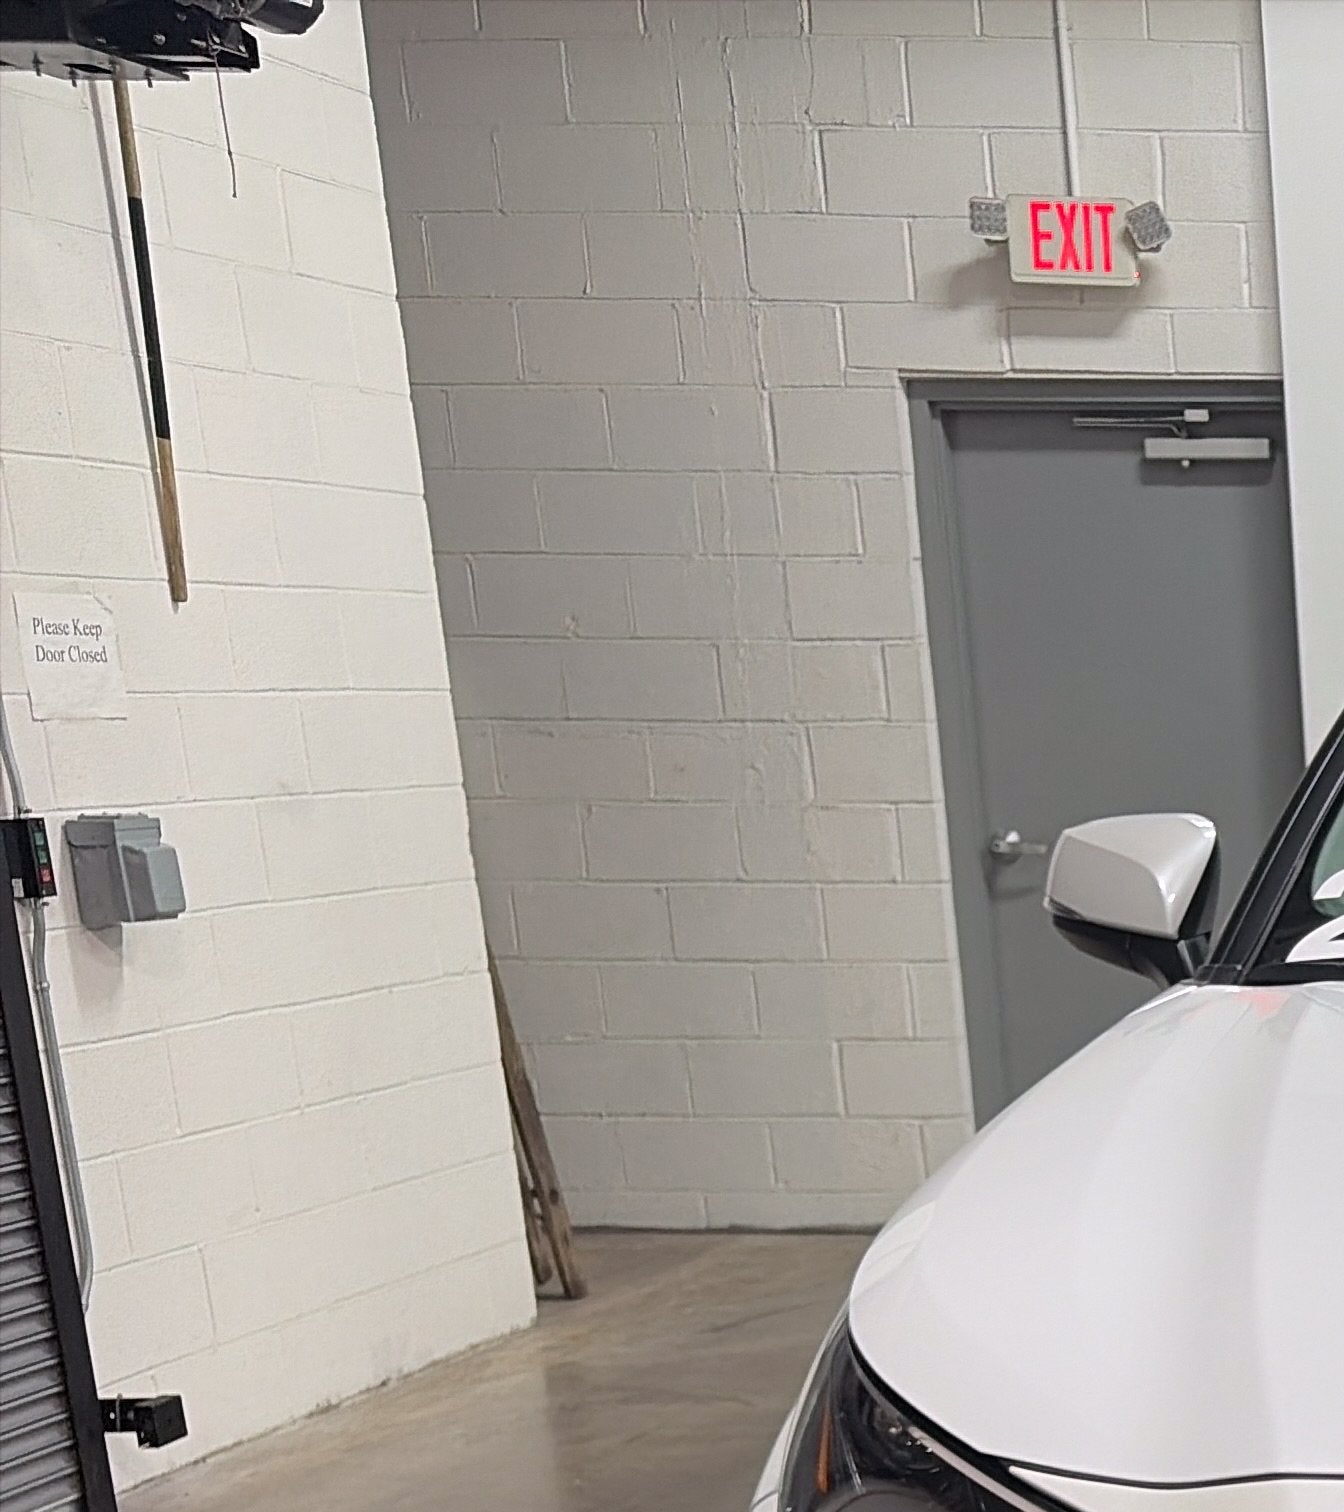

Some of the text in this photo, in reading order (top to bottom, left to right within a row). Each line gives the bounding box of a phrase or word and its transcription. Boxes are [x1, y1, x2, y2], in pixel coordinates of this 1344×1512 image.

[1029, 200, 1115, 273] EXIT
[32, 617, 103, 641] Please Keep
[35, 645, 108, 663] Door Closed
